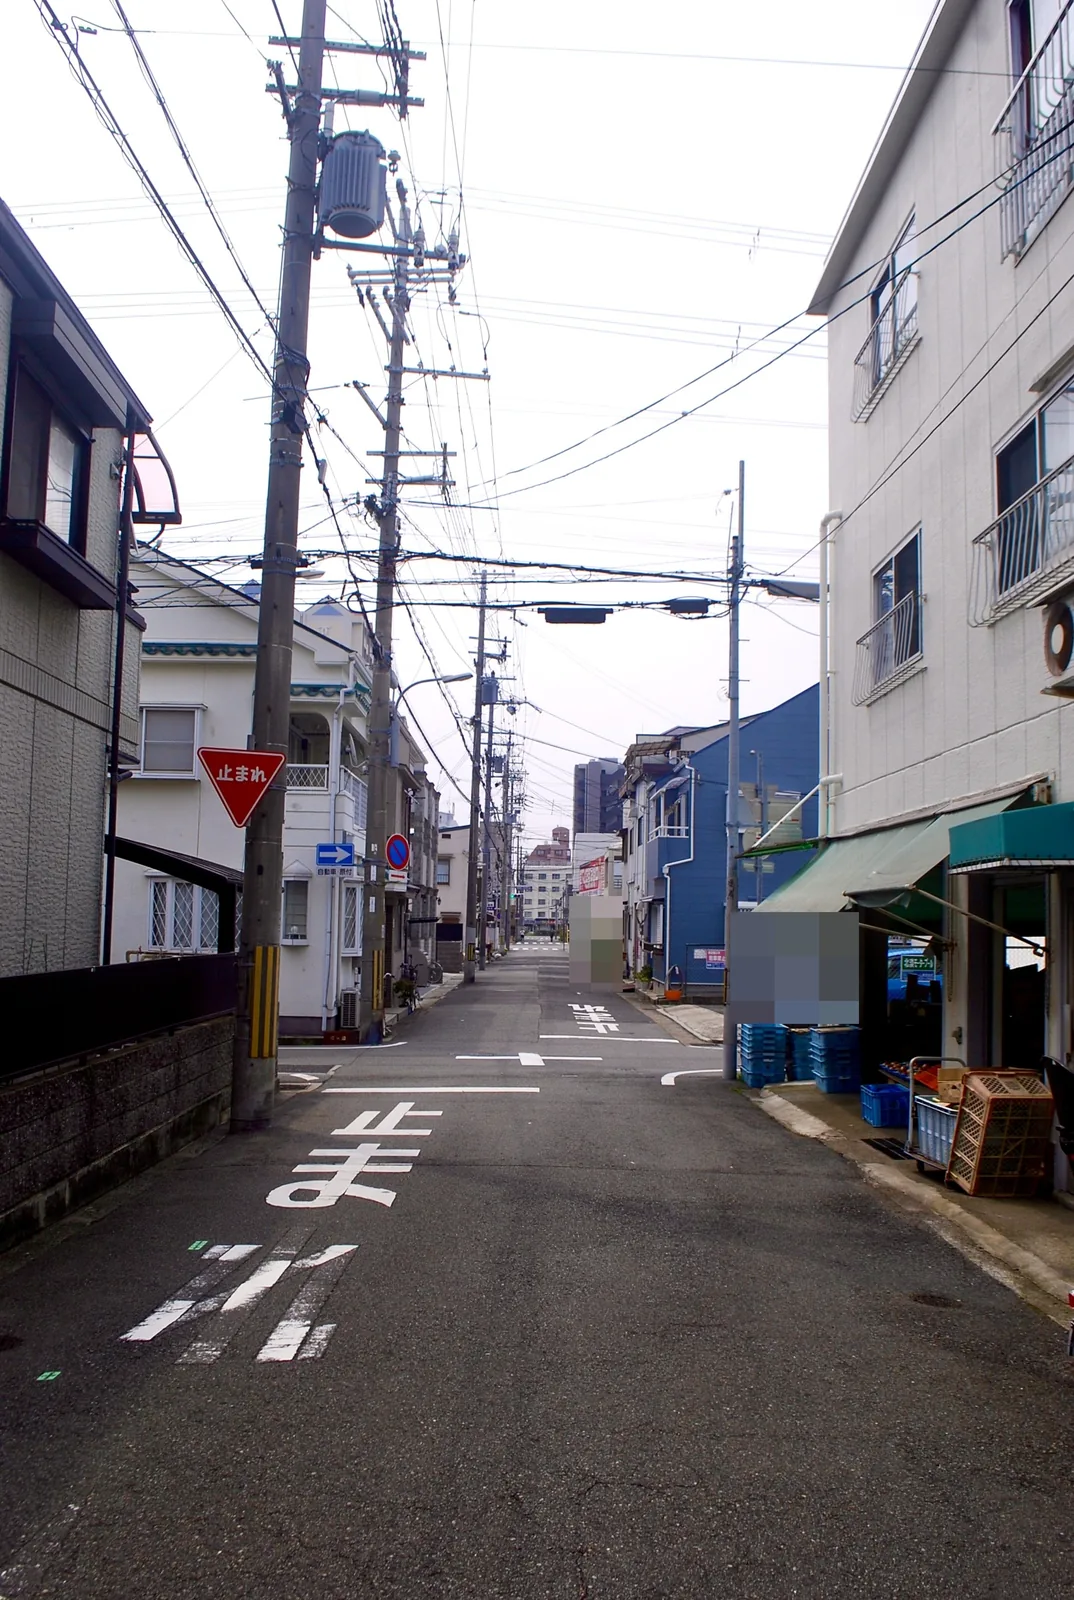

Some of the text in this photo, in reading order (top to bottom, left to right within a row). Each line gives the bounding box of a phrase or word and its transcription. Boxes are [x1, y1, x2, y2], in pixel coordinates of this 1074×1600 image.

[216, 763, 267, 783] 止まれ
[567, 1003, 620, 1034] 止まれ
[118, 1101, 444, 1366] 止まれ
